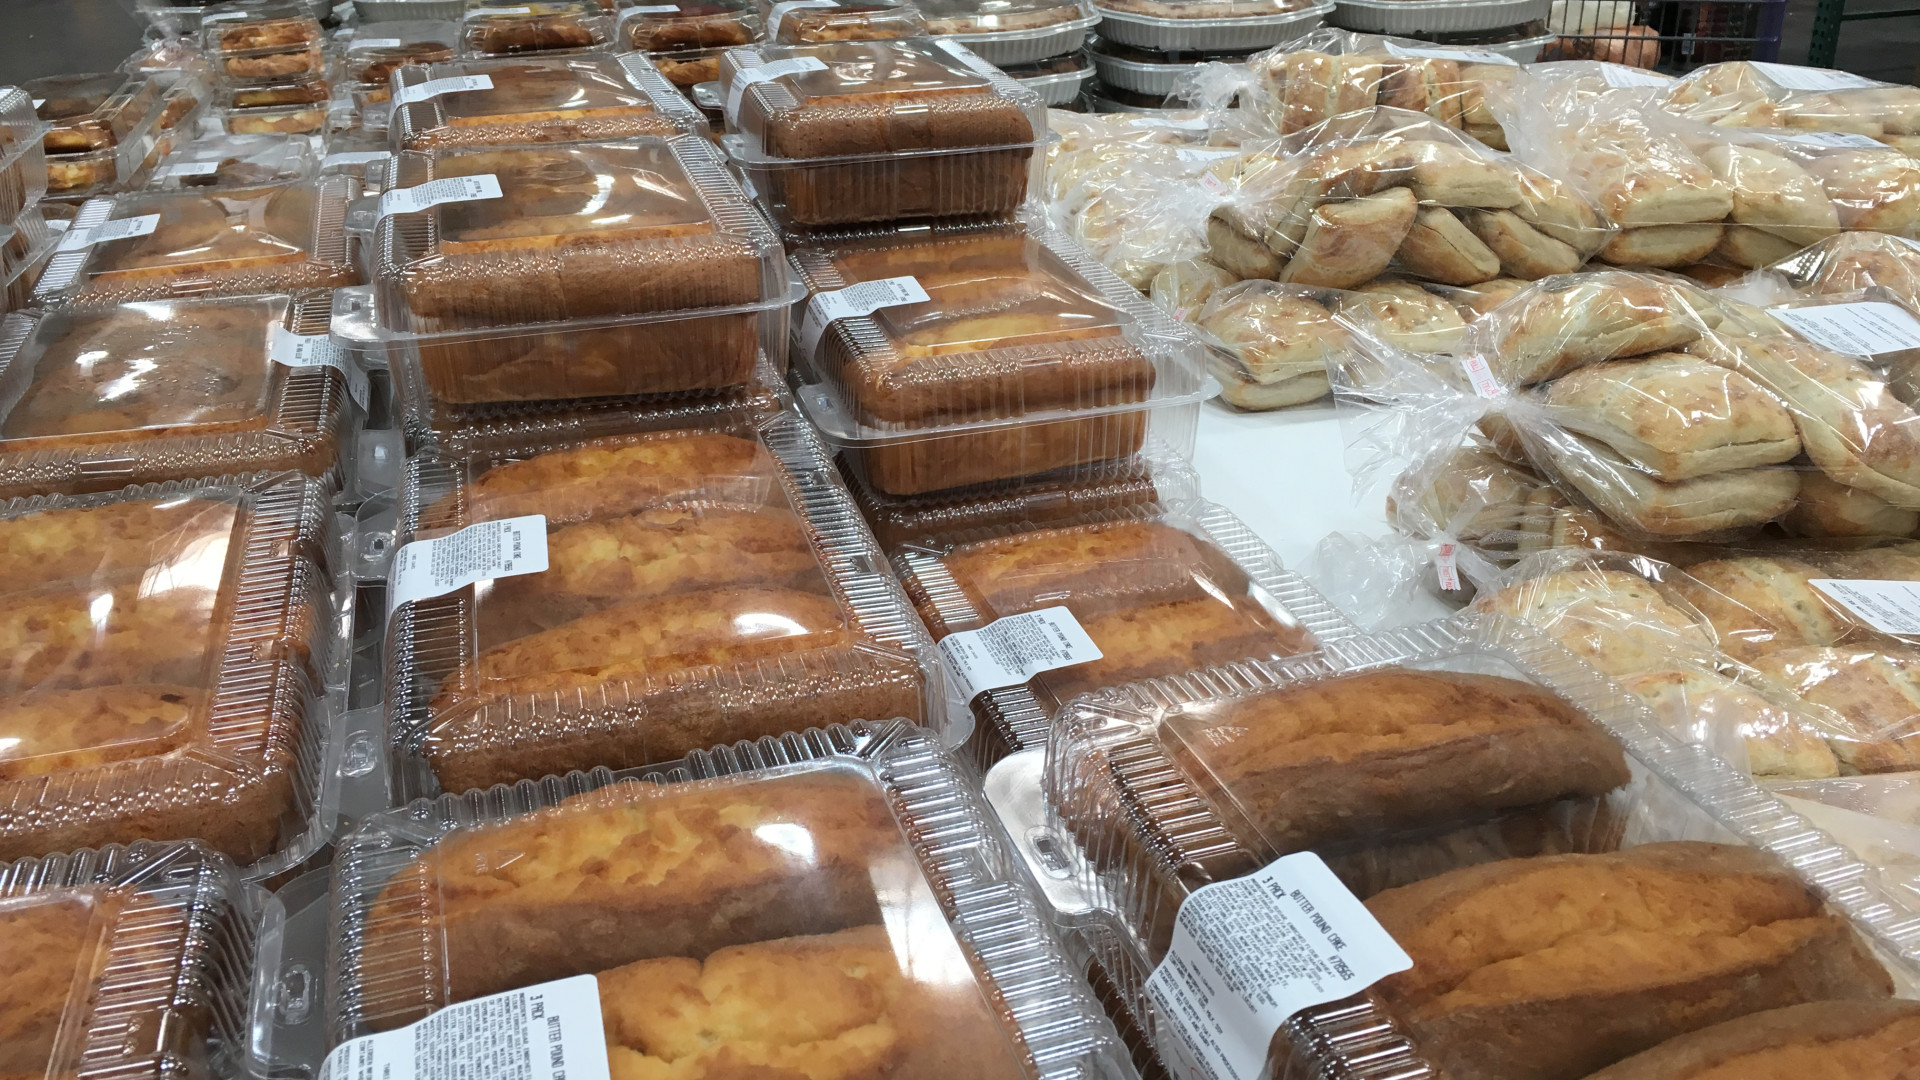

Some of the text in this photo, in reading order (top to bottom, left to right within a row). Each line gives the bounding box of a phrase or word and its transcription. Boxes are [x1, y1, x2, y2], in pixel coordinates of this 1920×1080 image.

[1261, 875, 1286, 899] 3 PACK
[1290, 889, 1346, 951] BUTTER POUND CAKE
[1328, 955, 1354, 980] #78565
[530, 1001, 544, 1021] PACK
[547, 1015, 562, 1042] BUTTER
[549, 1044, 564, 1069] POUND
